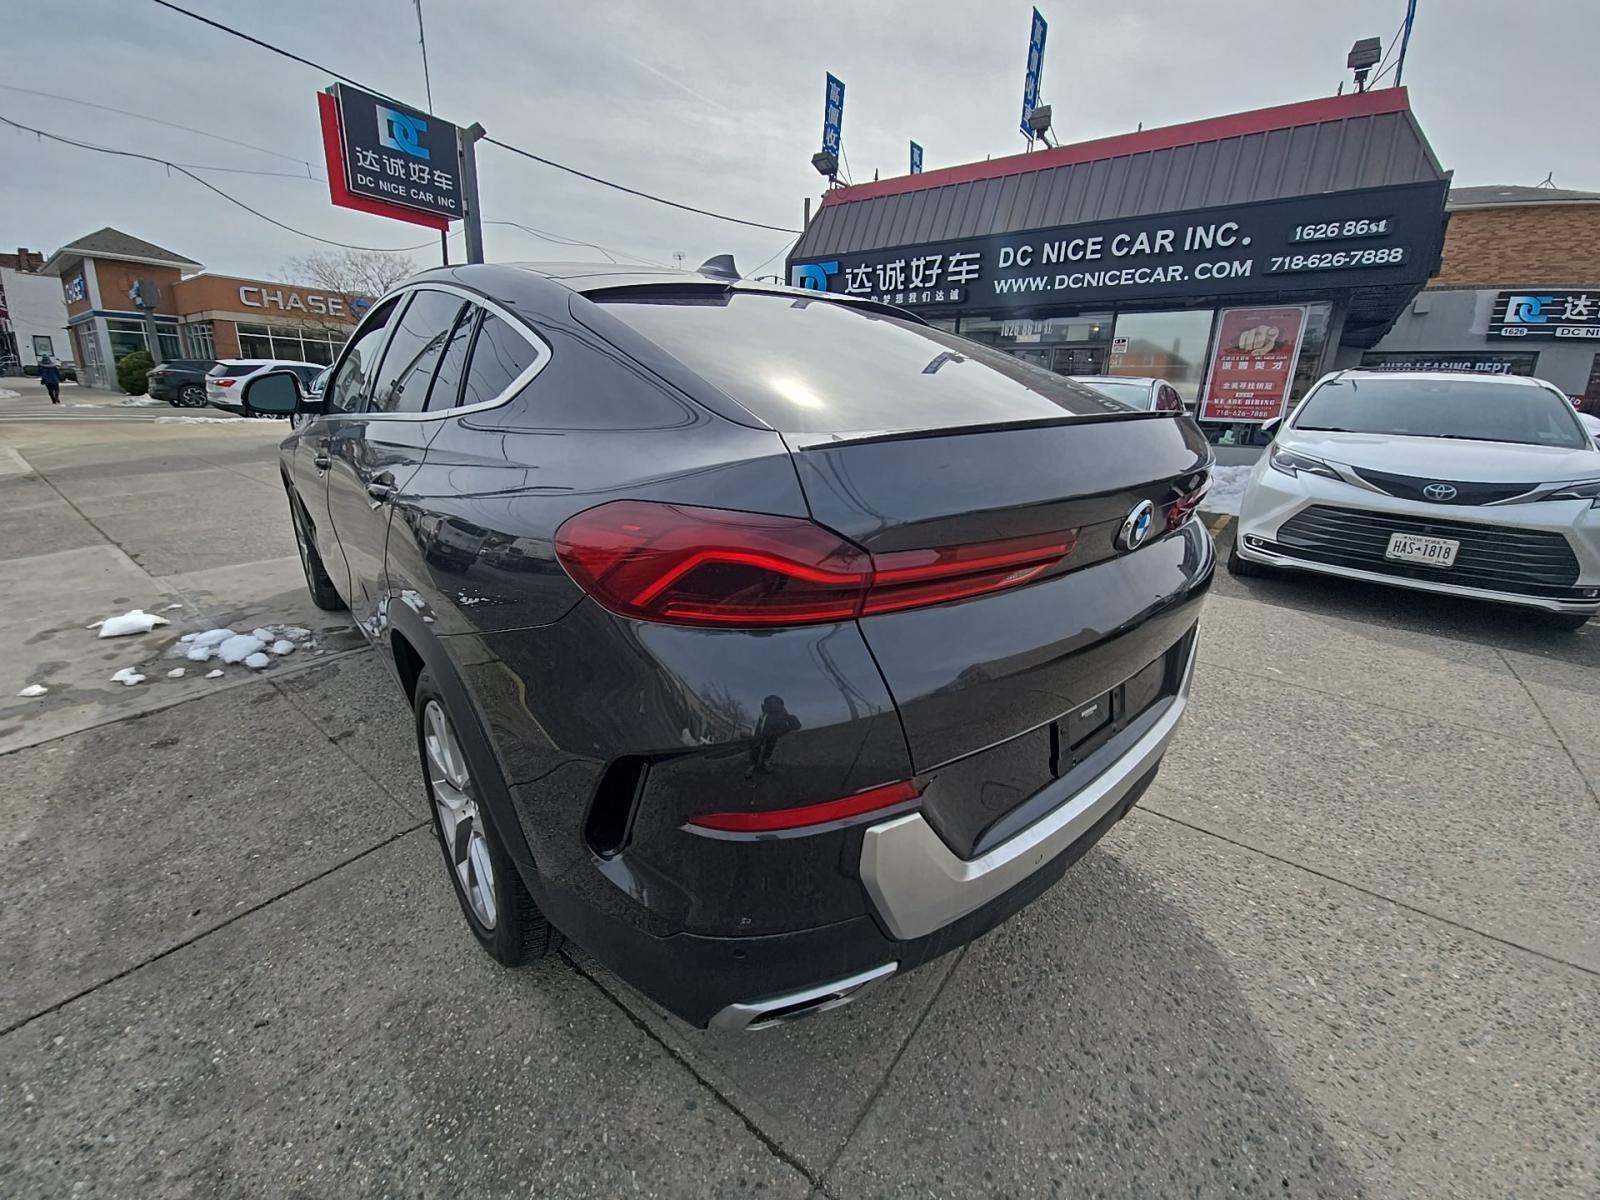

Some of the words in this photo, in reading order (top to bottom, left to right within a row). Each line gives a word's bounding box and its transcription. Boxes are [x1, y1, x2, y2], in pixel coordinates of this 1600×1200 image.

[356, 147, 453, 190] 达诚好车
[357, 174, 374, 187] DC
[379, 180, 407, 196] NICE
[410, 189, 434, 203] CAR
[438, 196, 456, 208] INC
[999, 245, 1033, 268] DC
[1042, 237, 1103, 264] NICE
[1111, 229, 1175, 257] CAR
[1184, 222, 1252, 251] INC.
[1295, 223, 1340, 241] 1626
[1343, 219, 1388, 236] 86st
[844, 252, 981, 294] 达诚好车
[994, 259, 1253, 294] WWW.DCNICECAR.COM
[1270, 248, 1403, 271] 718-626-7888
[239, 286, 346, 317] CHASE
[1560, 328, 1580, 336] DC
